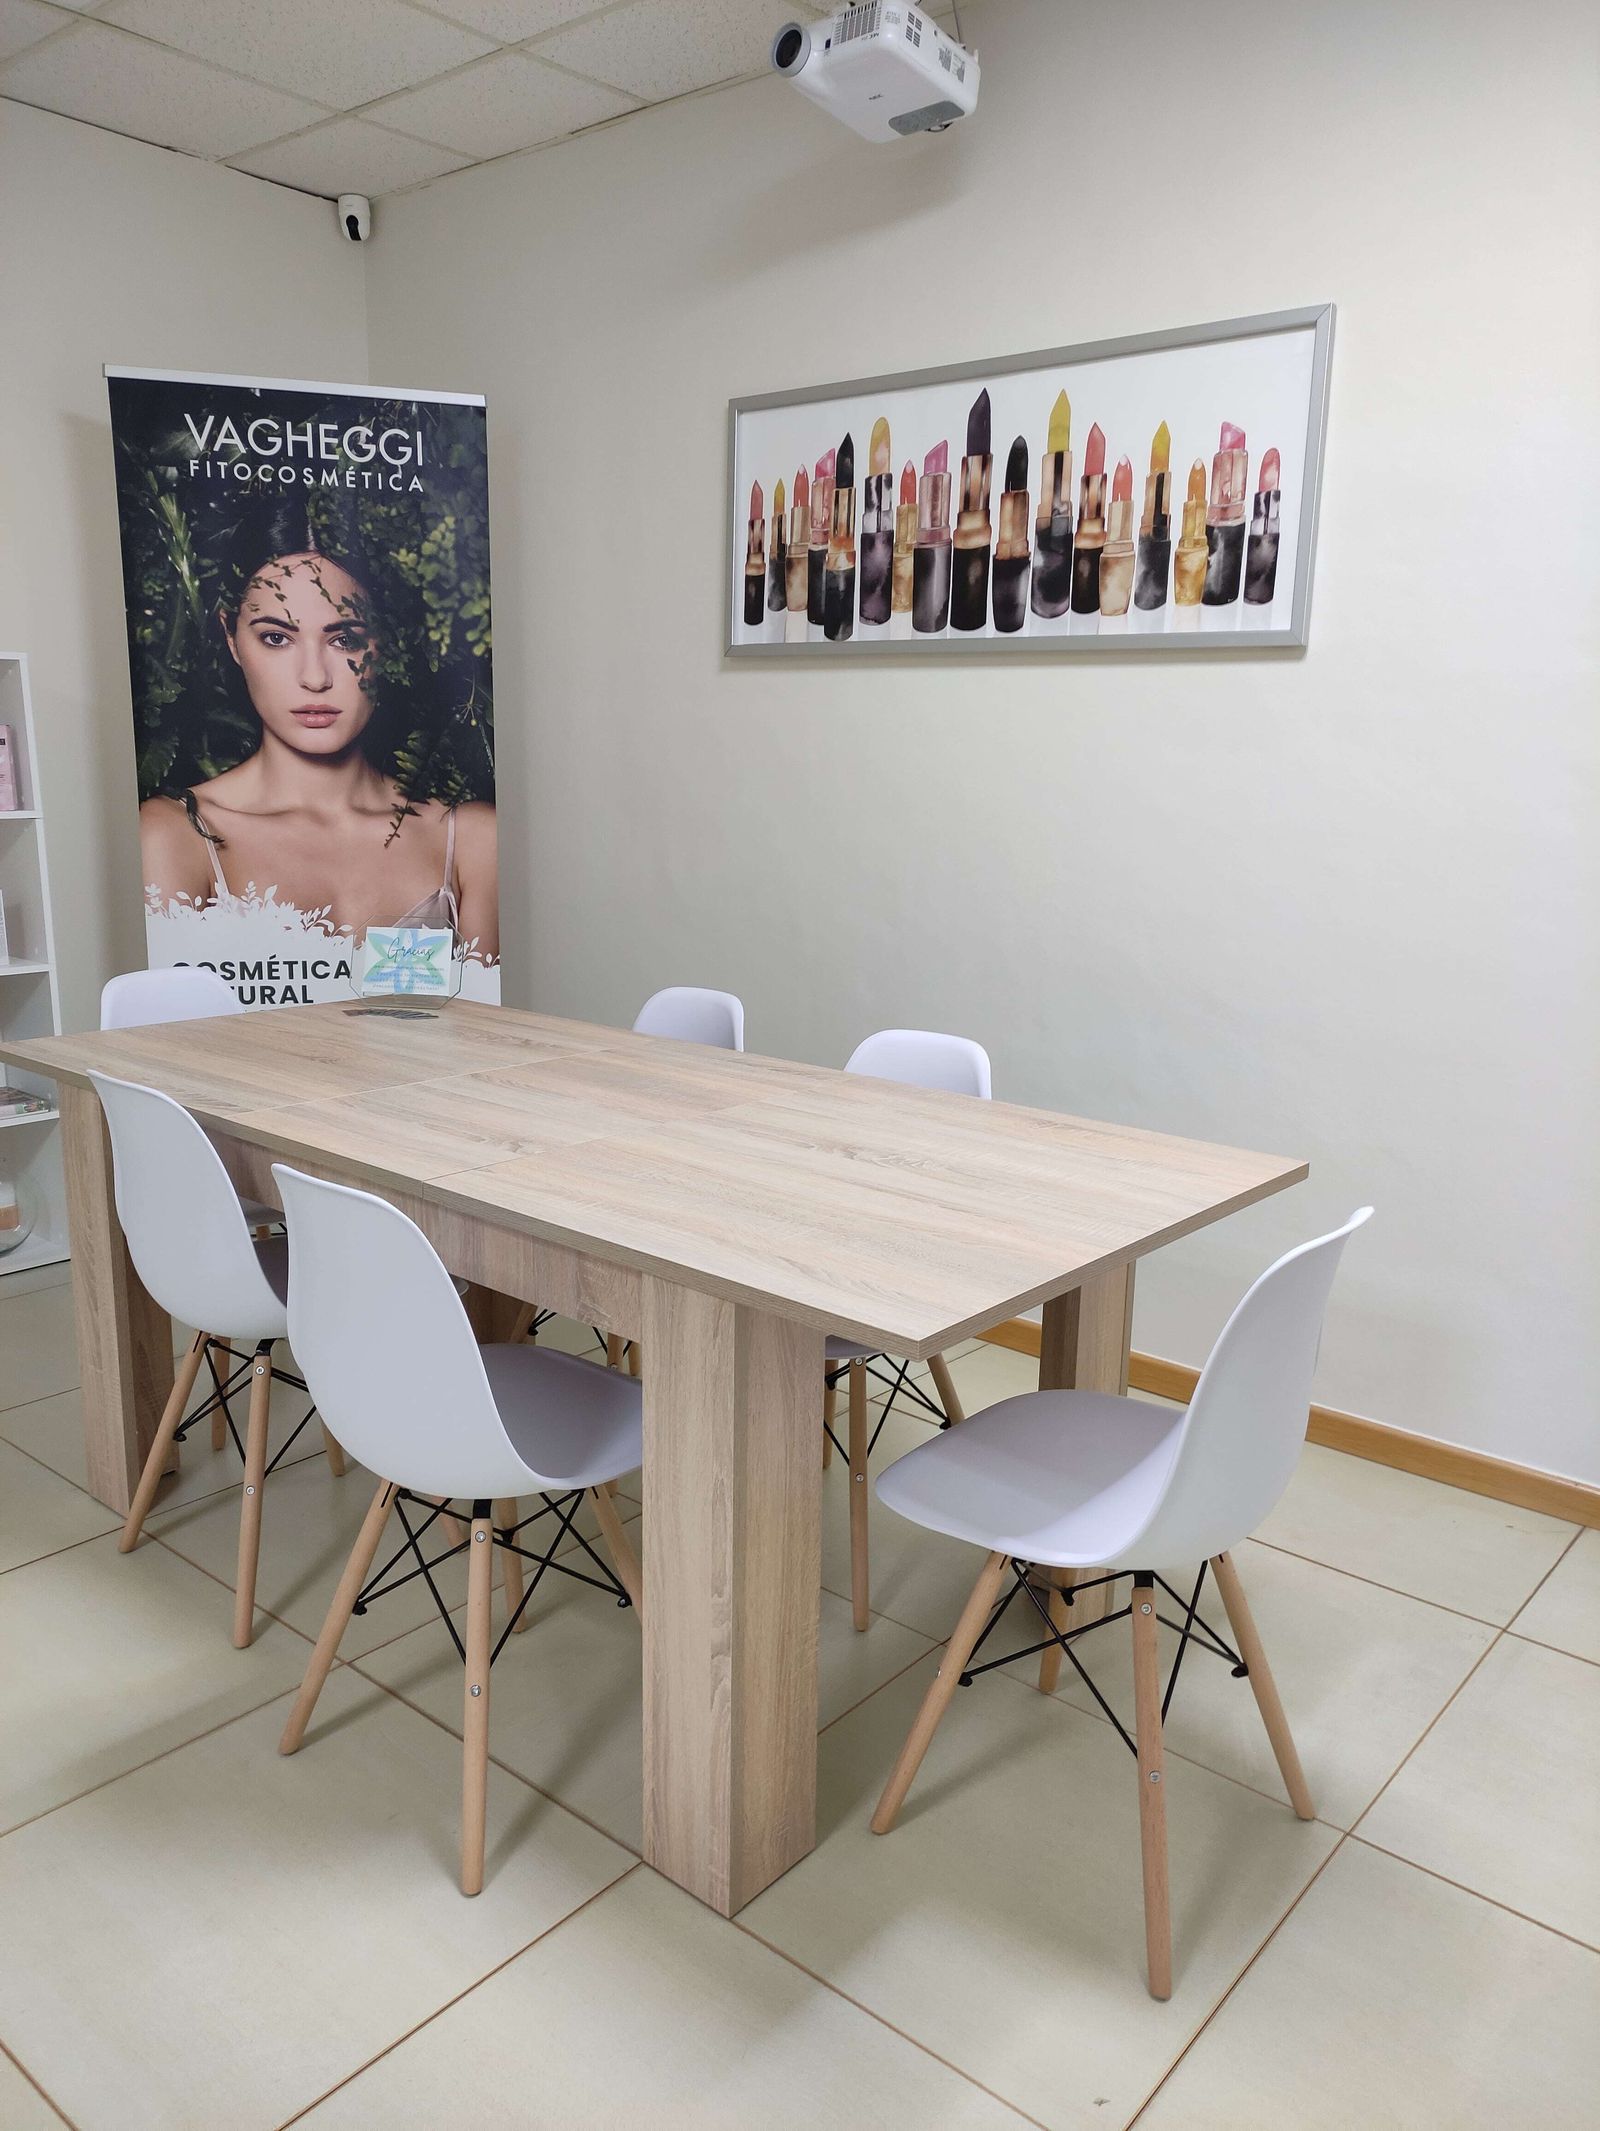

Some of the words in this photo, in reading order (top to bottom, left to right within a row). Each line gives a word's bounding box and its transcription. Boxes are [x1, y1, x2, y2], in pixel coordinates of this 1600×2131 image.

[184, 413, 423, 466] VAGHEGGI
[189, 458, 424, 492] FITOCOSMÉTICA
[173, 953, 353, 981] SMÉTICA
[230, 984, 314, 1005] URAL
